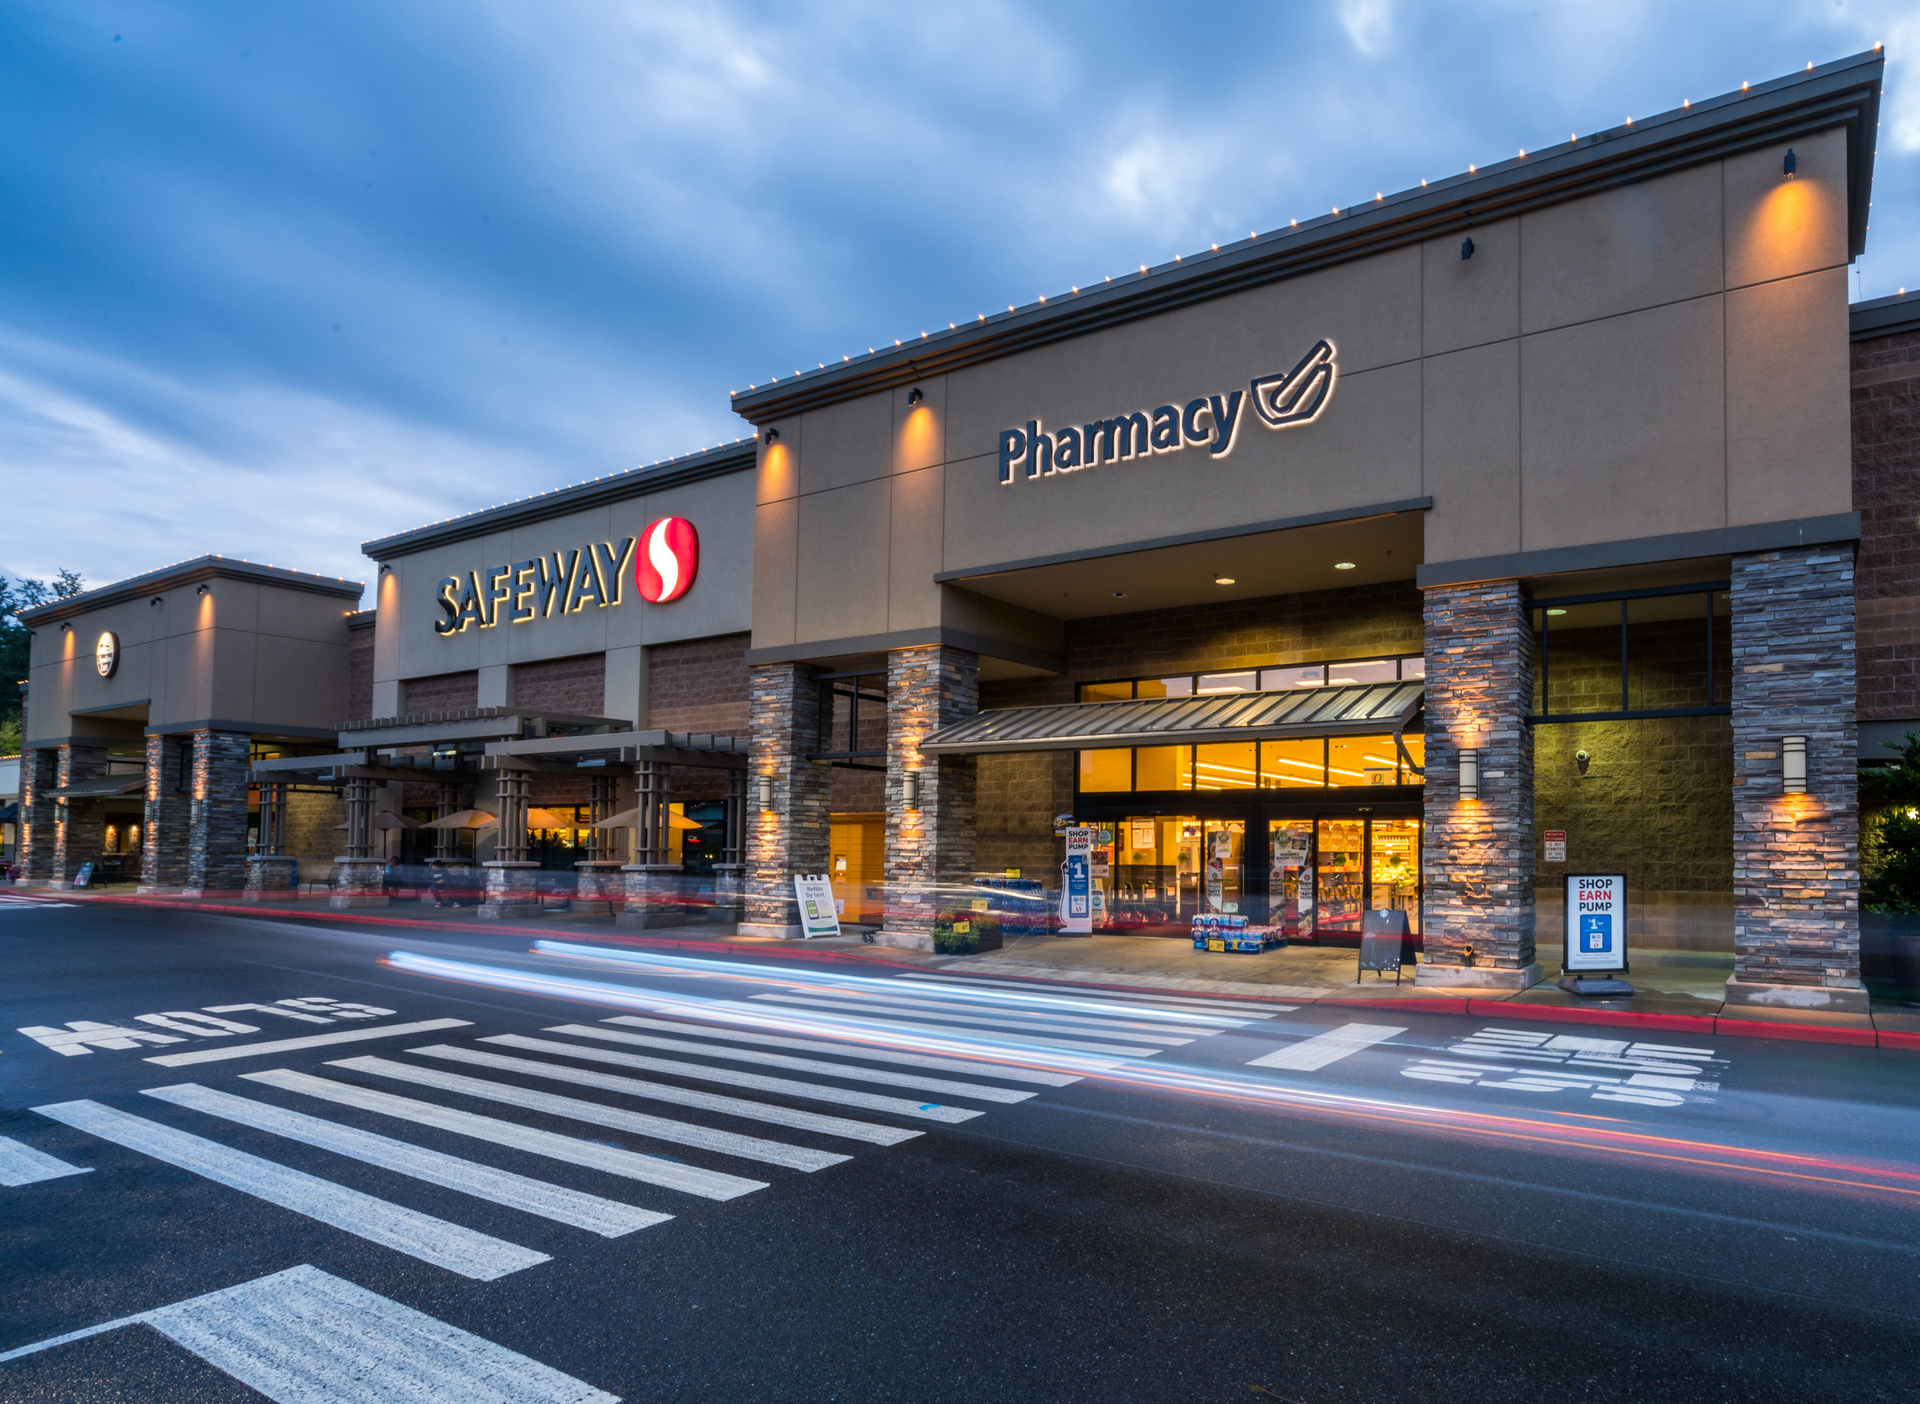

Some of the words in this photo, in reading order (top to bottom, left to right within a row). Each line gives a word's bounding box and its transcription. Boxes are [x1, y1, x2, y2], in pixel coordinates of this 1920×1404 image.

[999, 390, 1245, 485] Pharmacy
[434, 537, 636, 636] SAFEWAY
[1069, 862, 1085, 879] $1
[1578, 879, 1613, 889] SHOP
[1579, 890, 1612, 900] EARN
[1579, 902, 1612, 912] PUMP
[17, 997, 397, 1056] SLOW
